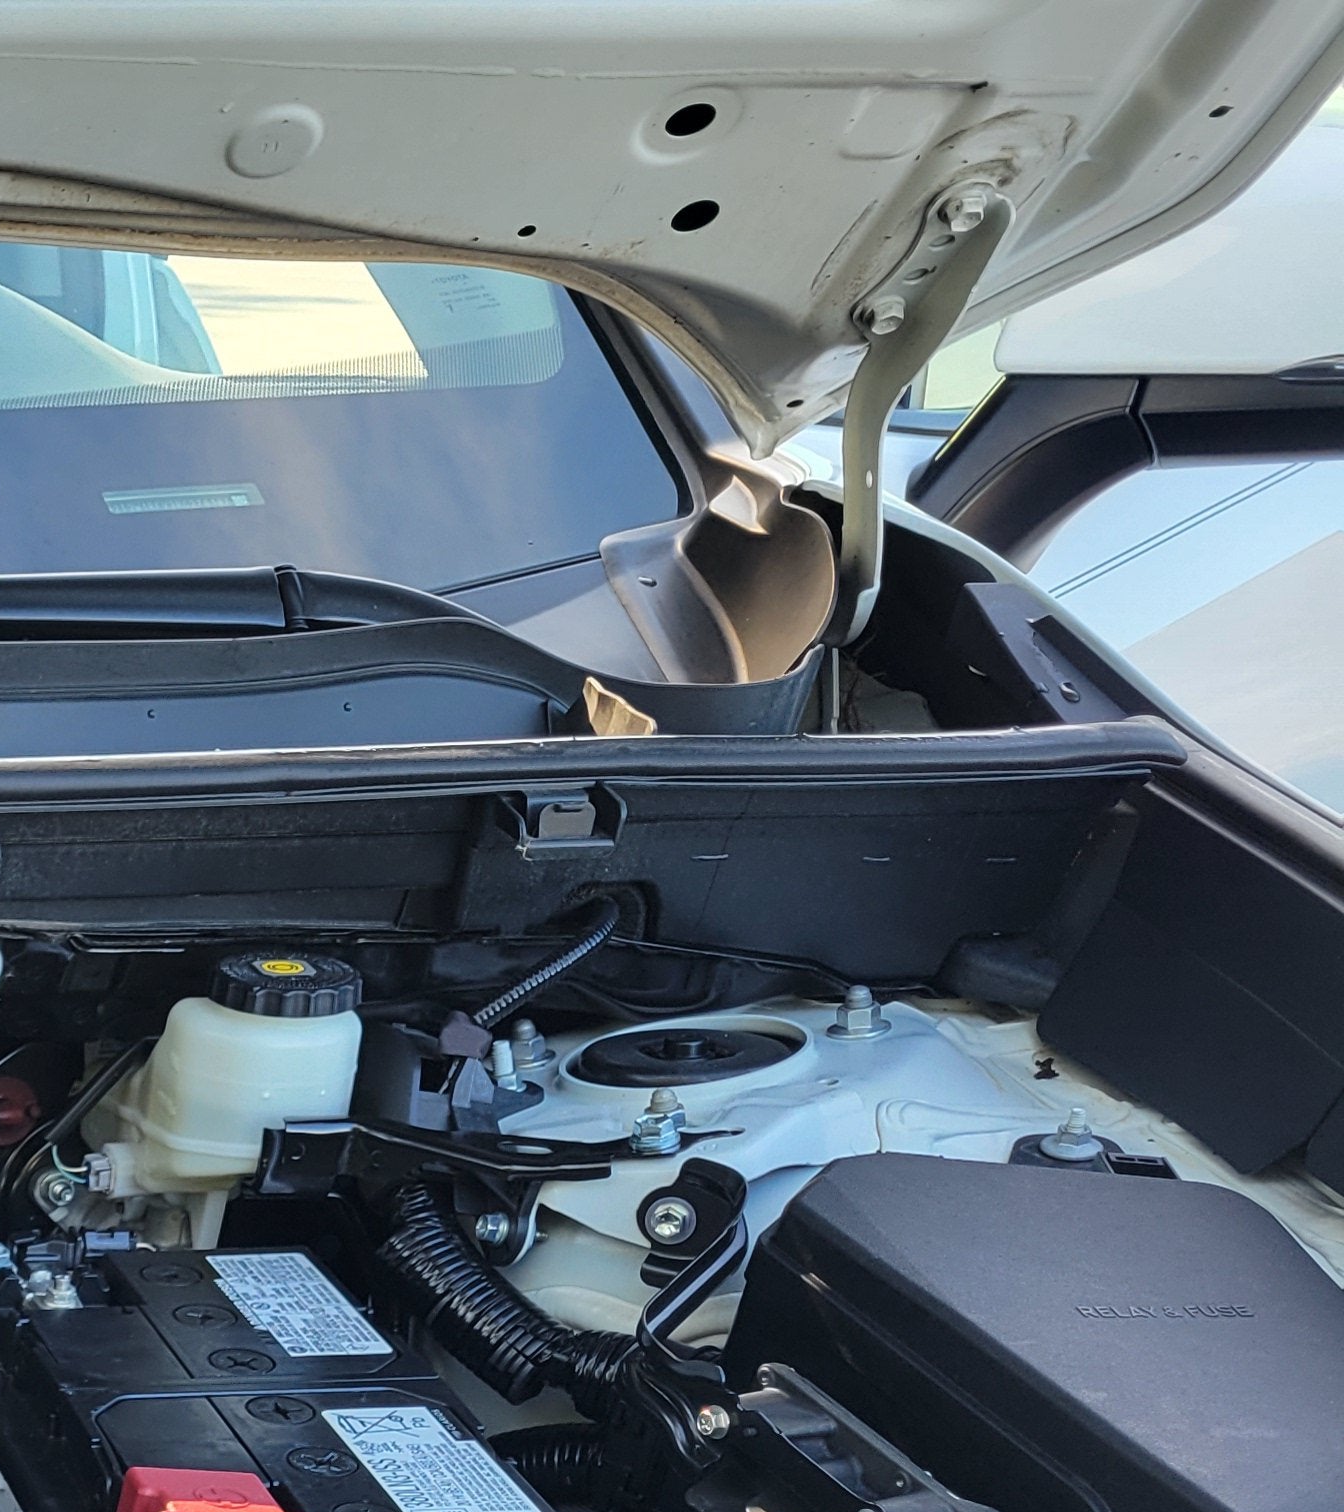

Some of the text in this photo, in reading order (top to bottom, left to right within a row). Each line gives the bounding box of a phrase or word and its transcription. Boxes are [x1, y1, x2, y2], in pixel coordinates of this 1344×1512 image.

[1075, 1305, 1255, 1319] RELAY & FUSE
